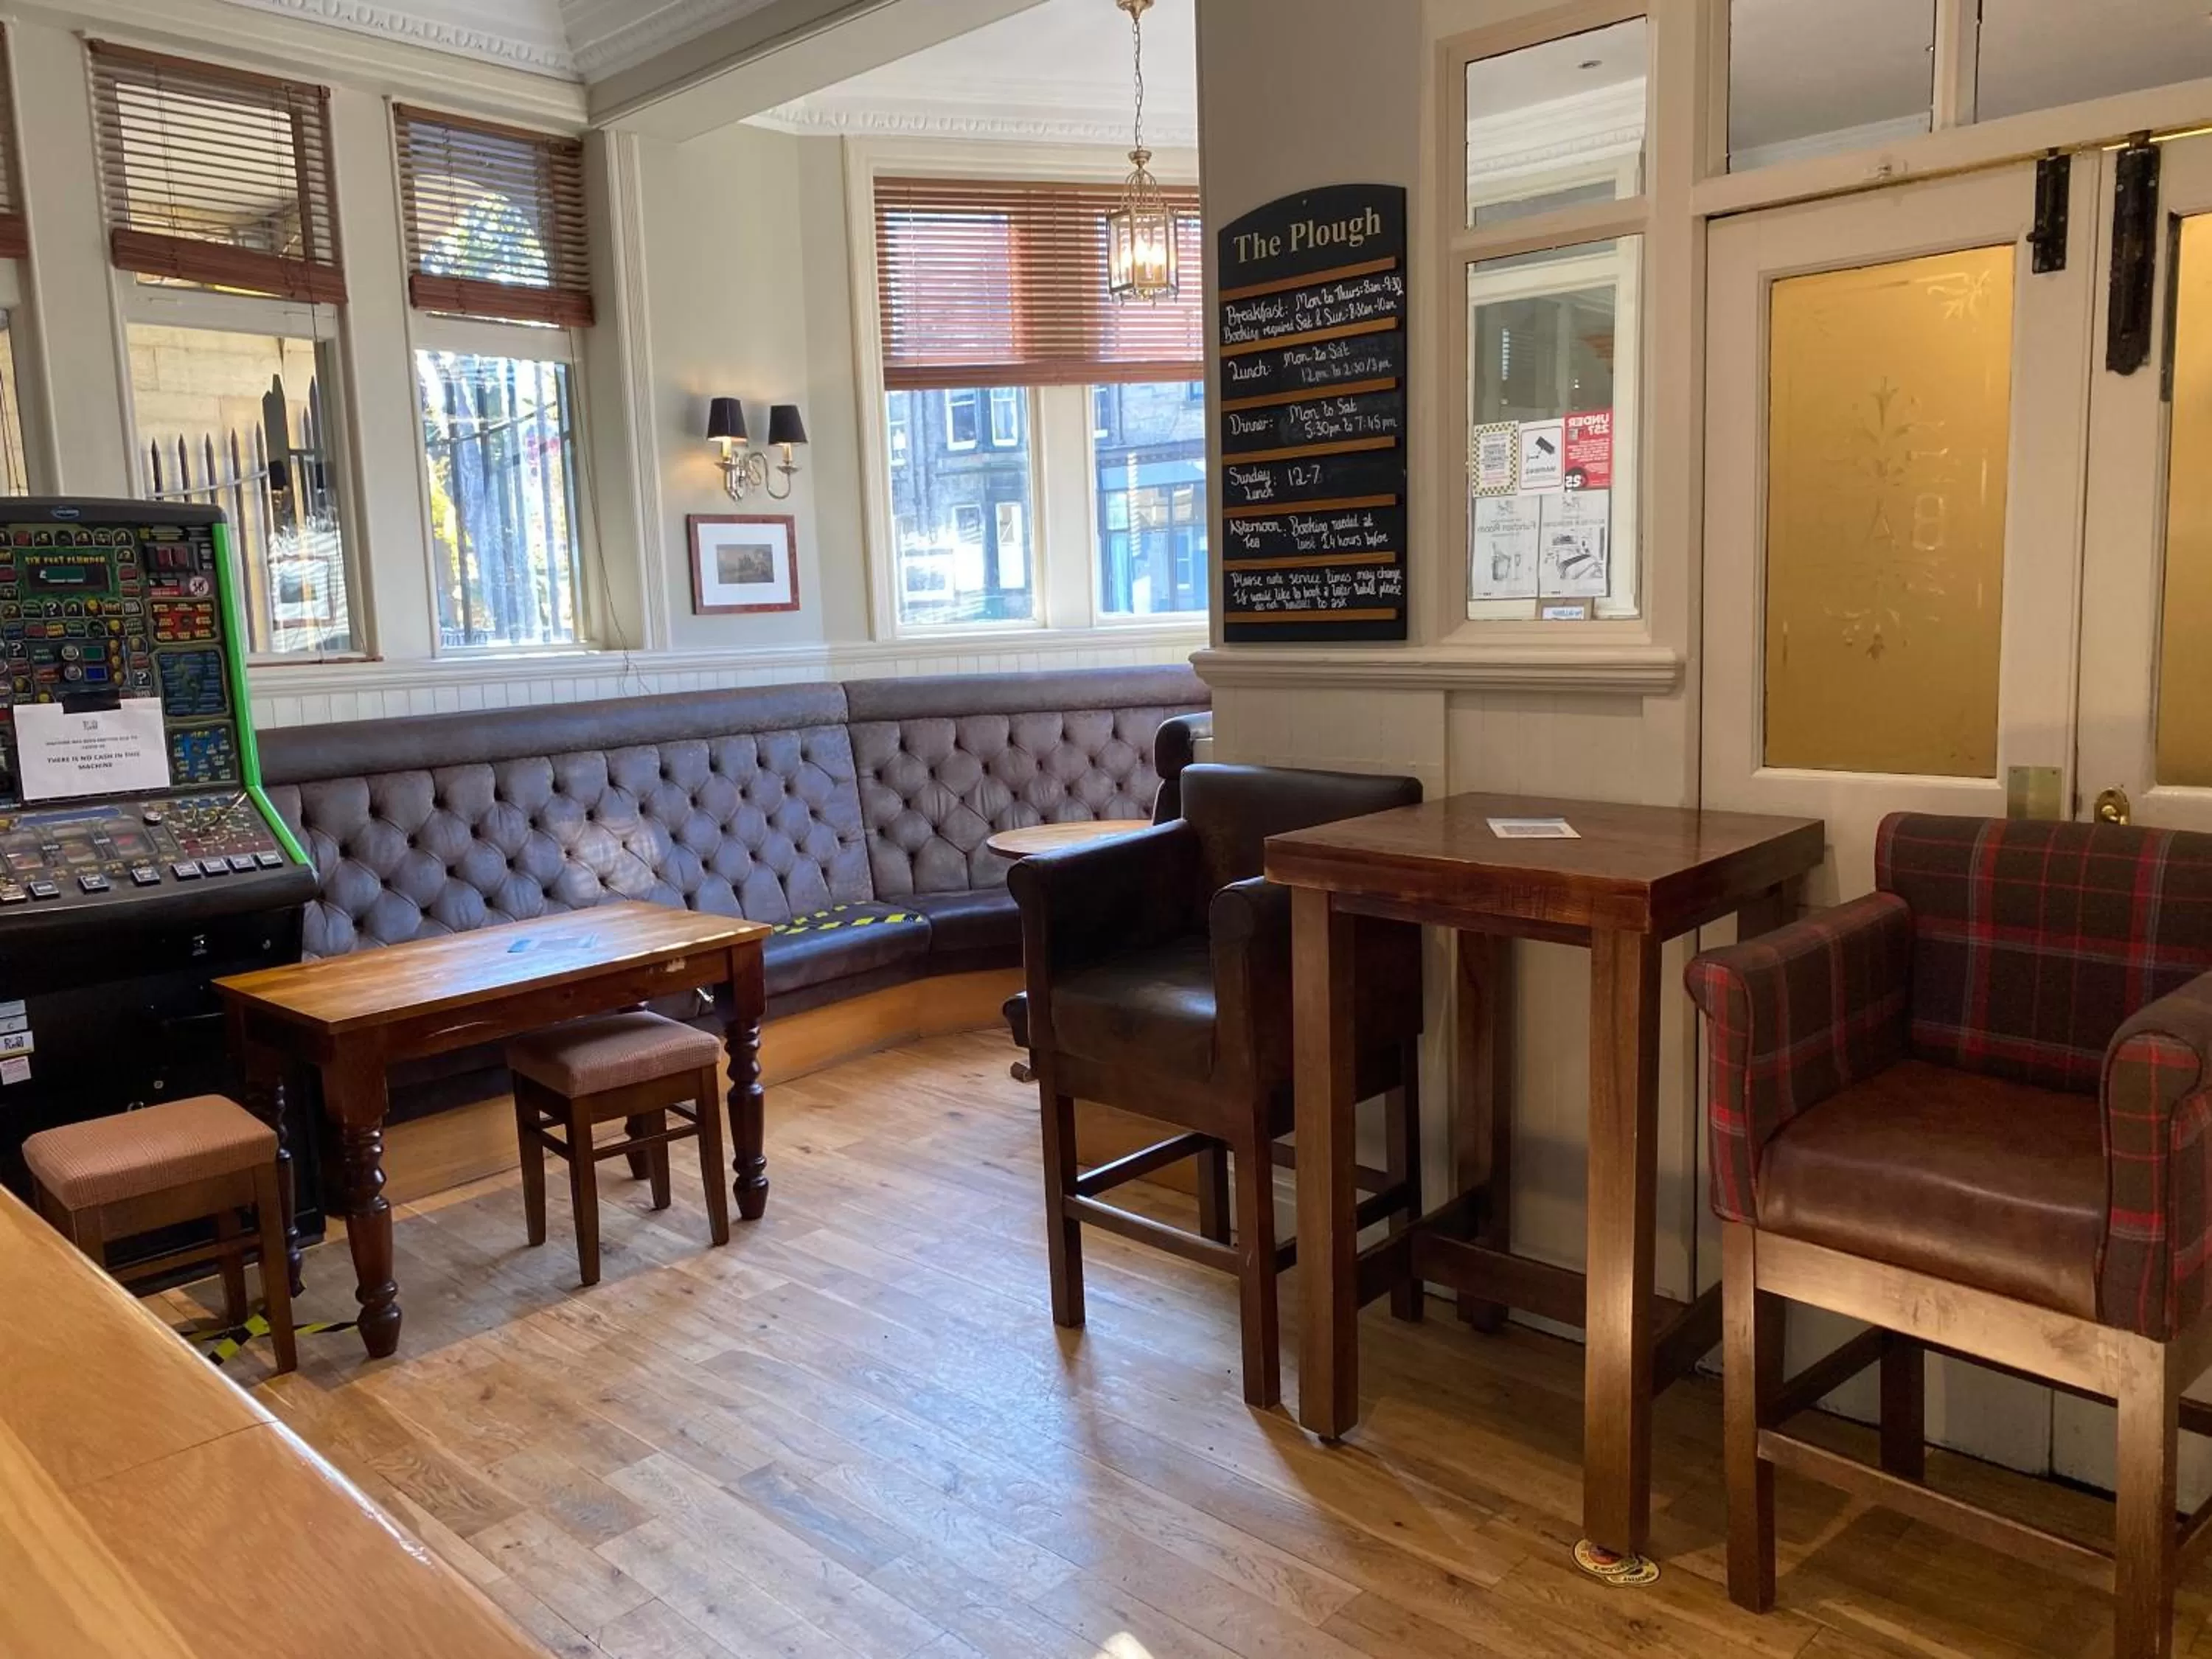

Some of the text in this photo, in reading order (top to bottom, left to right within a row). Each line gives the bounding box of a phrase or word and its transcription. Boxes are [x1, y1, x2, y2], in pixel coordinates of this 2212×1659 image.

[1234, 206, 1381, 263] The Plough
[1295, 293, 1322, 310] Mon
[1321, 288, 1334, 304] to
[1295, 313, 1312, 330] Sat
[1284, 351, 1311, 367] Mon
[1312, 346, 1326, 361] to
[1328, 341, 1351, 359] Sat
[1229, 397, 1357, 435] Dinner: Mon to Sat
[1343, 417, 1353, 433] to
[1243, 533, 1260, 549] Tea
[1337, 533, 1362, 547] hours
